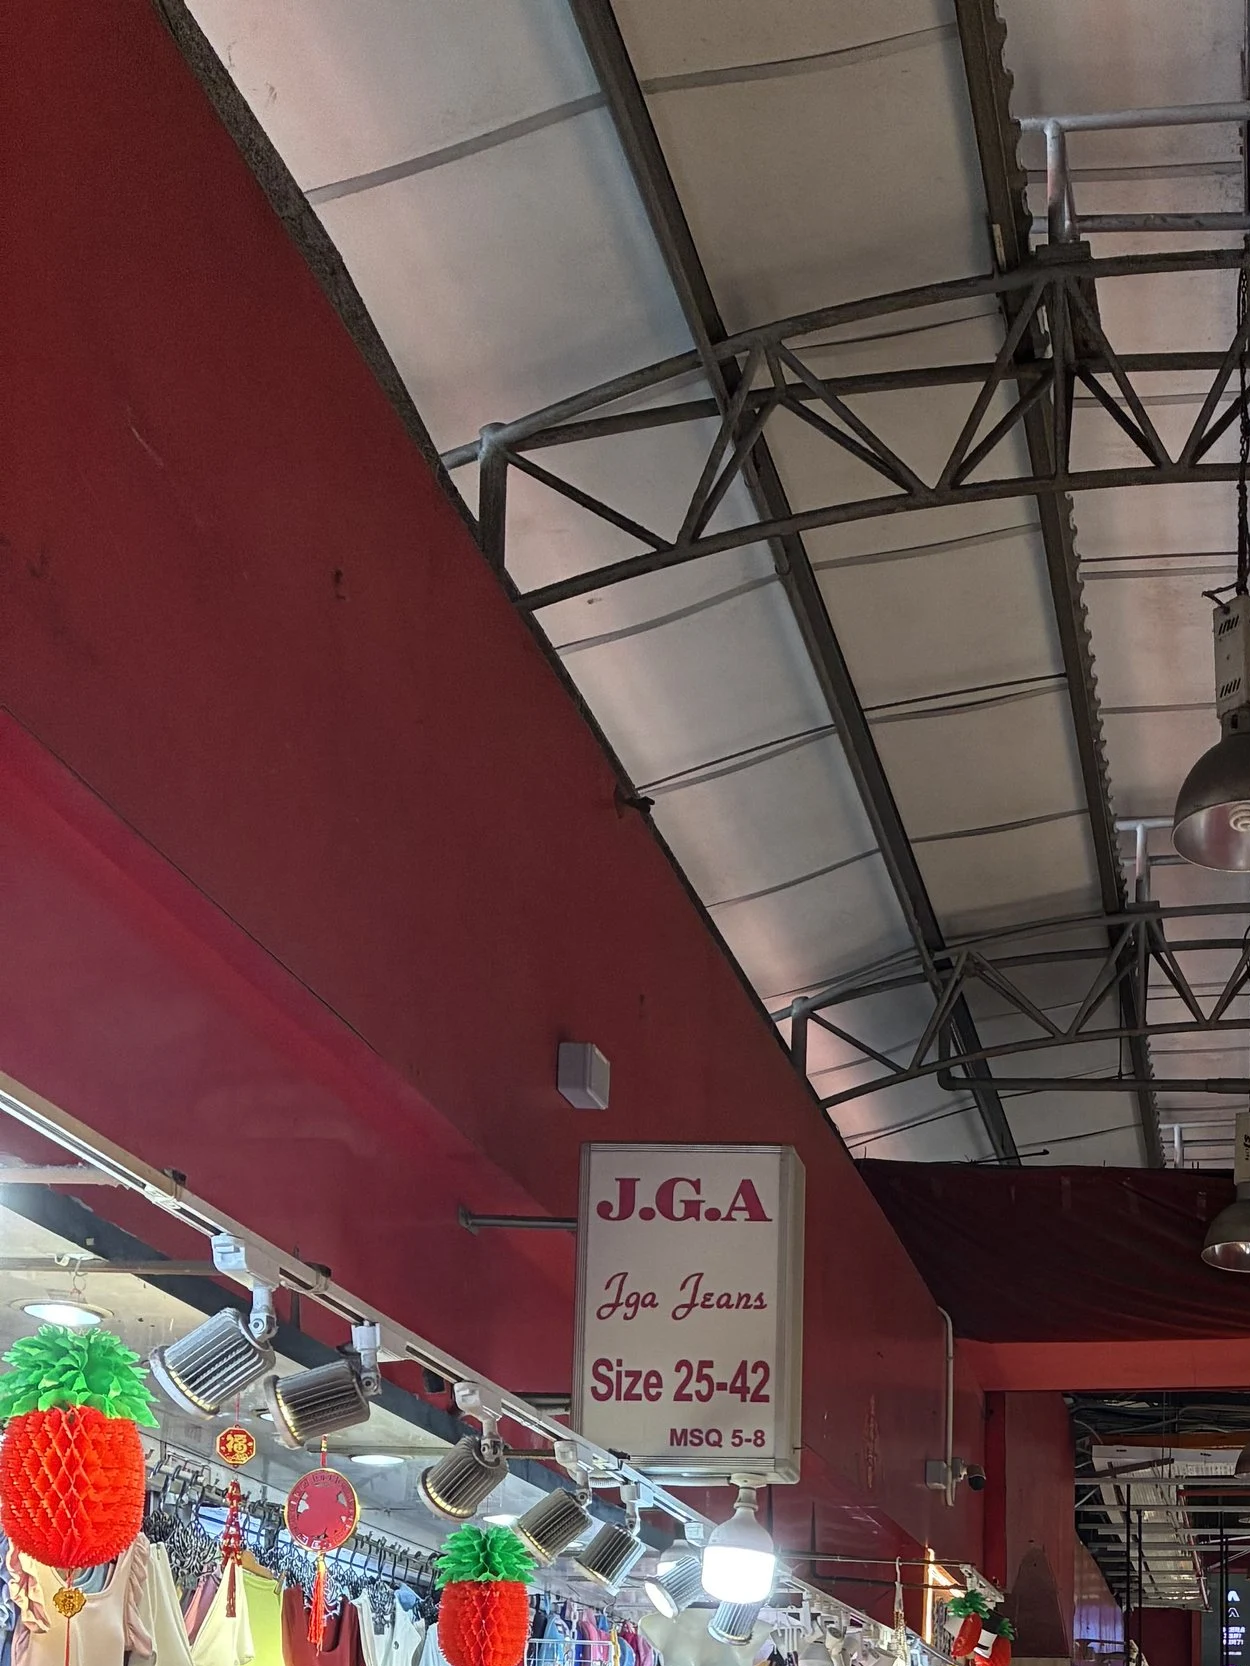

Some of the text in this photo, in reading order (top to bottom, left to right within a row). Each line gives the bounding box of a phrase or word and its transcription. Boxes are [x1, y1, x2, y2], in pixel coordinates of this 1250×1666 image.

[596, 1177, 772, 1222] J.G.A
[596, 1271, 768, 1321] Jga Jeans
[590, 1358, 771, 1403] Size 25-42
[225, 1433, 249, 1452] 福
[668, 1428, 766, 1449] MSQ 5-8
